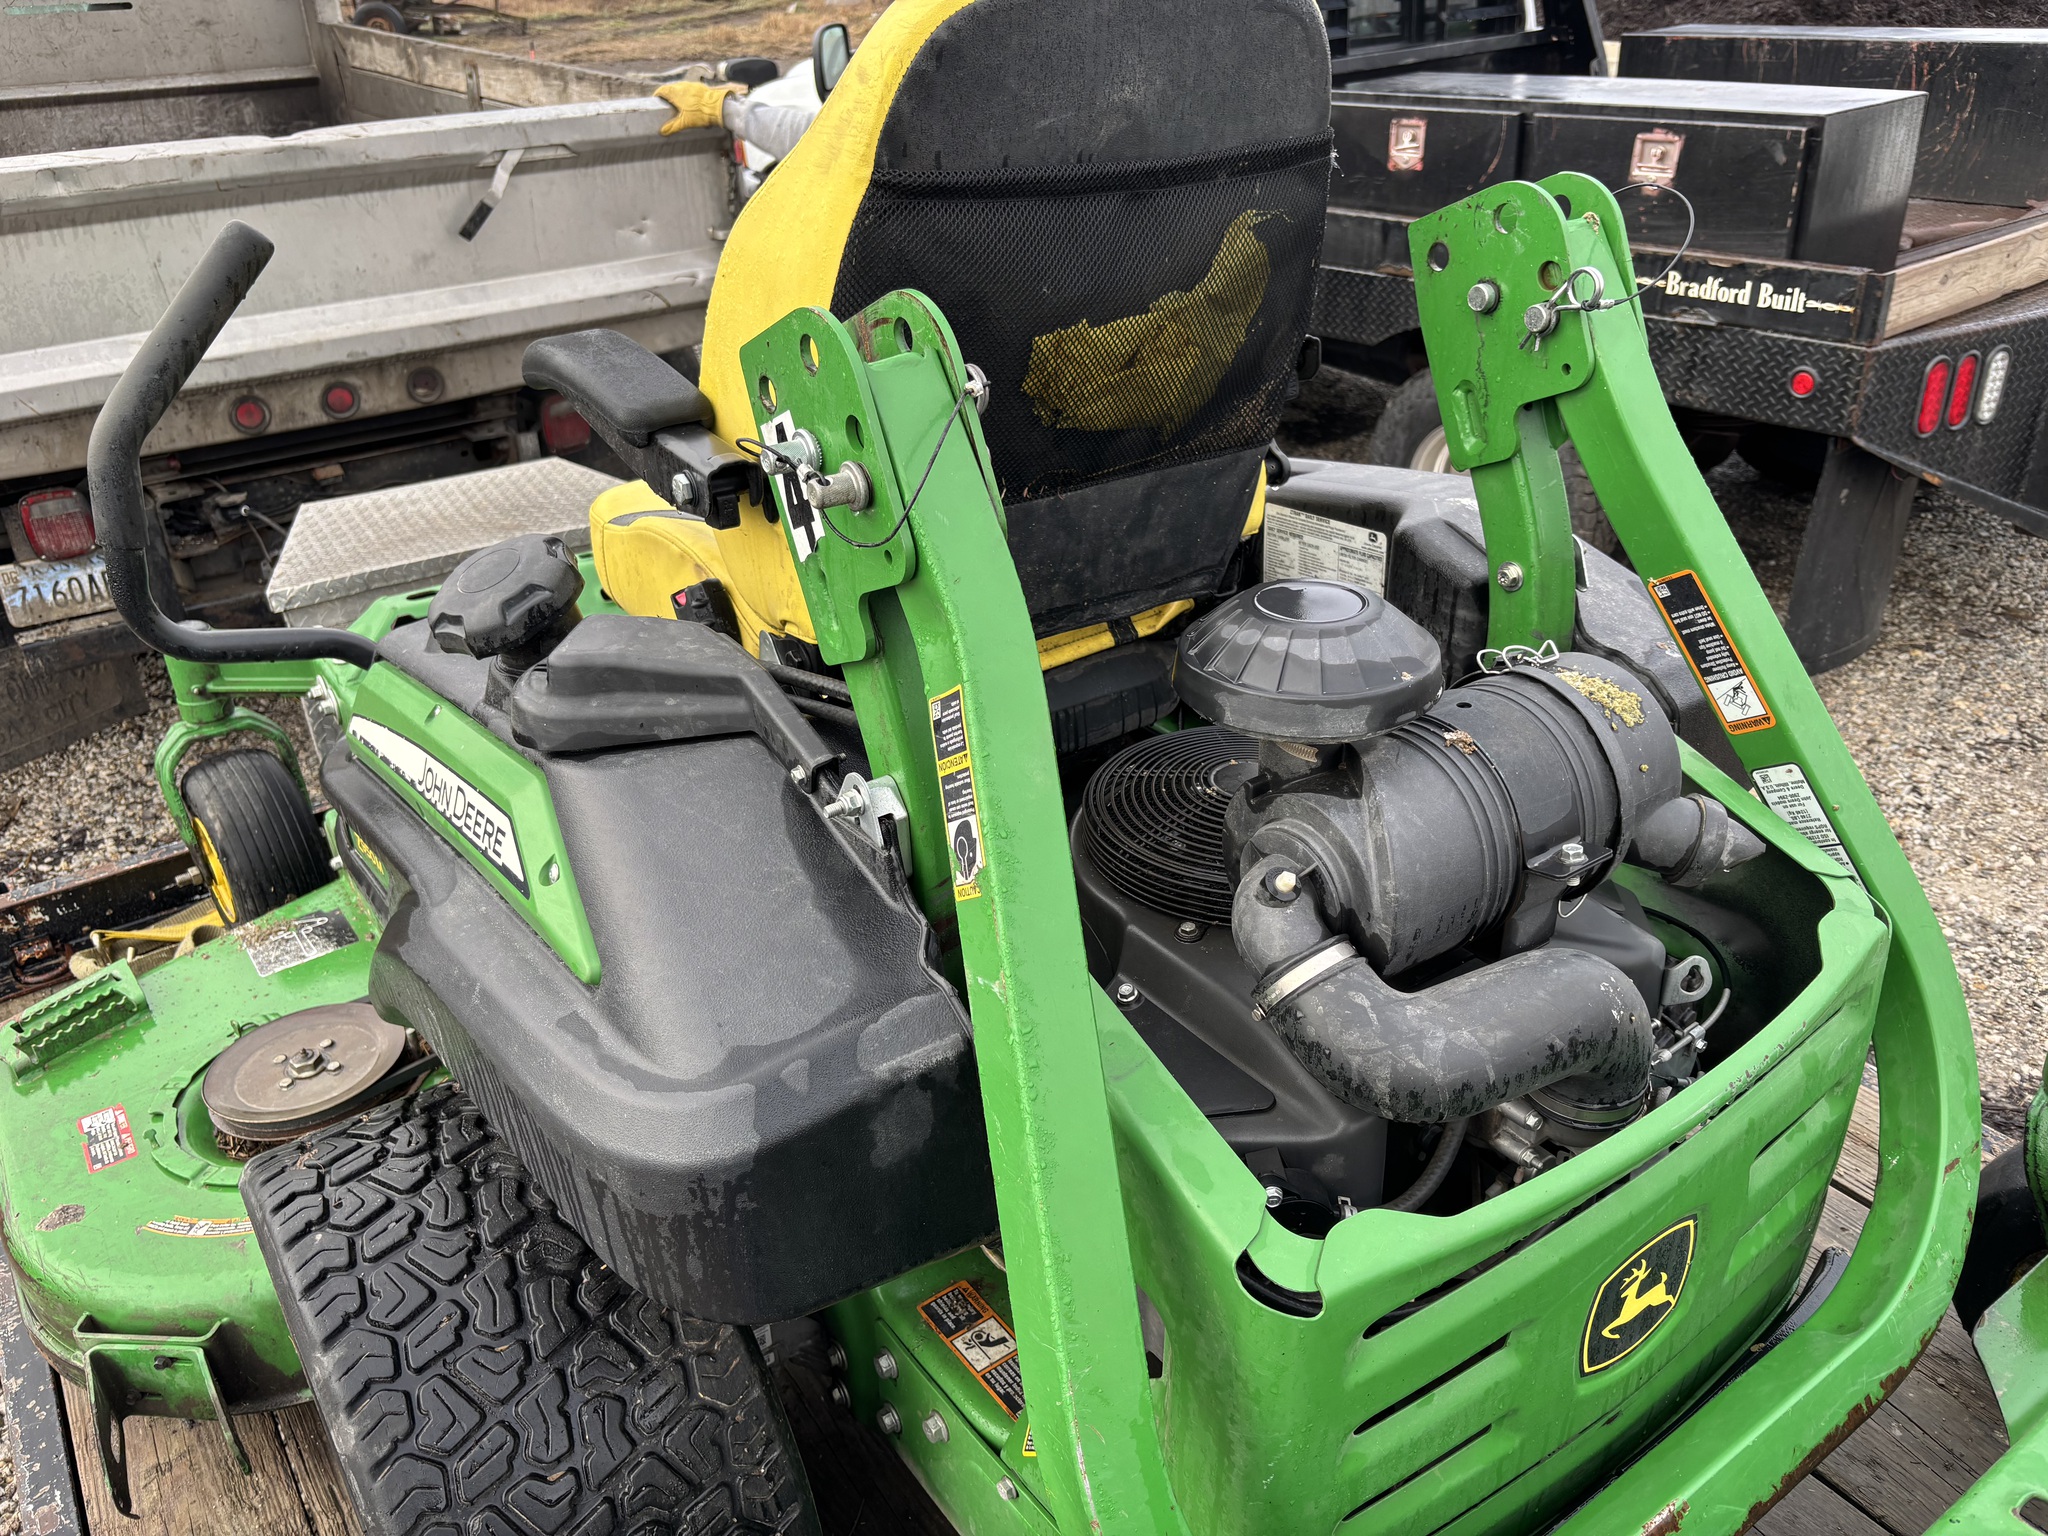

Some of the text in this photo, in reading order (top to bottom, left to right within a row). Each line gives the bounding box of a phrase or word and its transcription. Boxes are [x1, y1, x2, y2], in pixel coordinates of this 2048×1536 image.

[1665, 270, 1806, 313] Bradford Built
[1728, 718, 1763, 732] WARNING
[938, 755, 963, 774] ATENCIÓN
[418, 758, 505, 859] JOHN DEERE
[958, 886, 980, 898] AUTION
